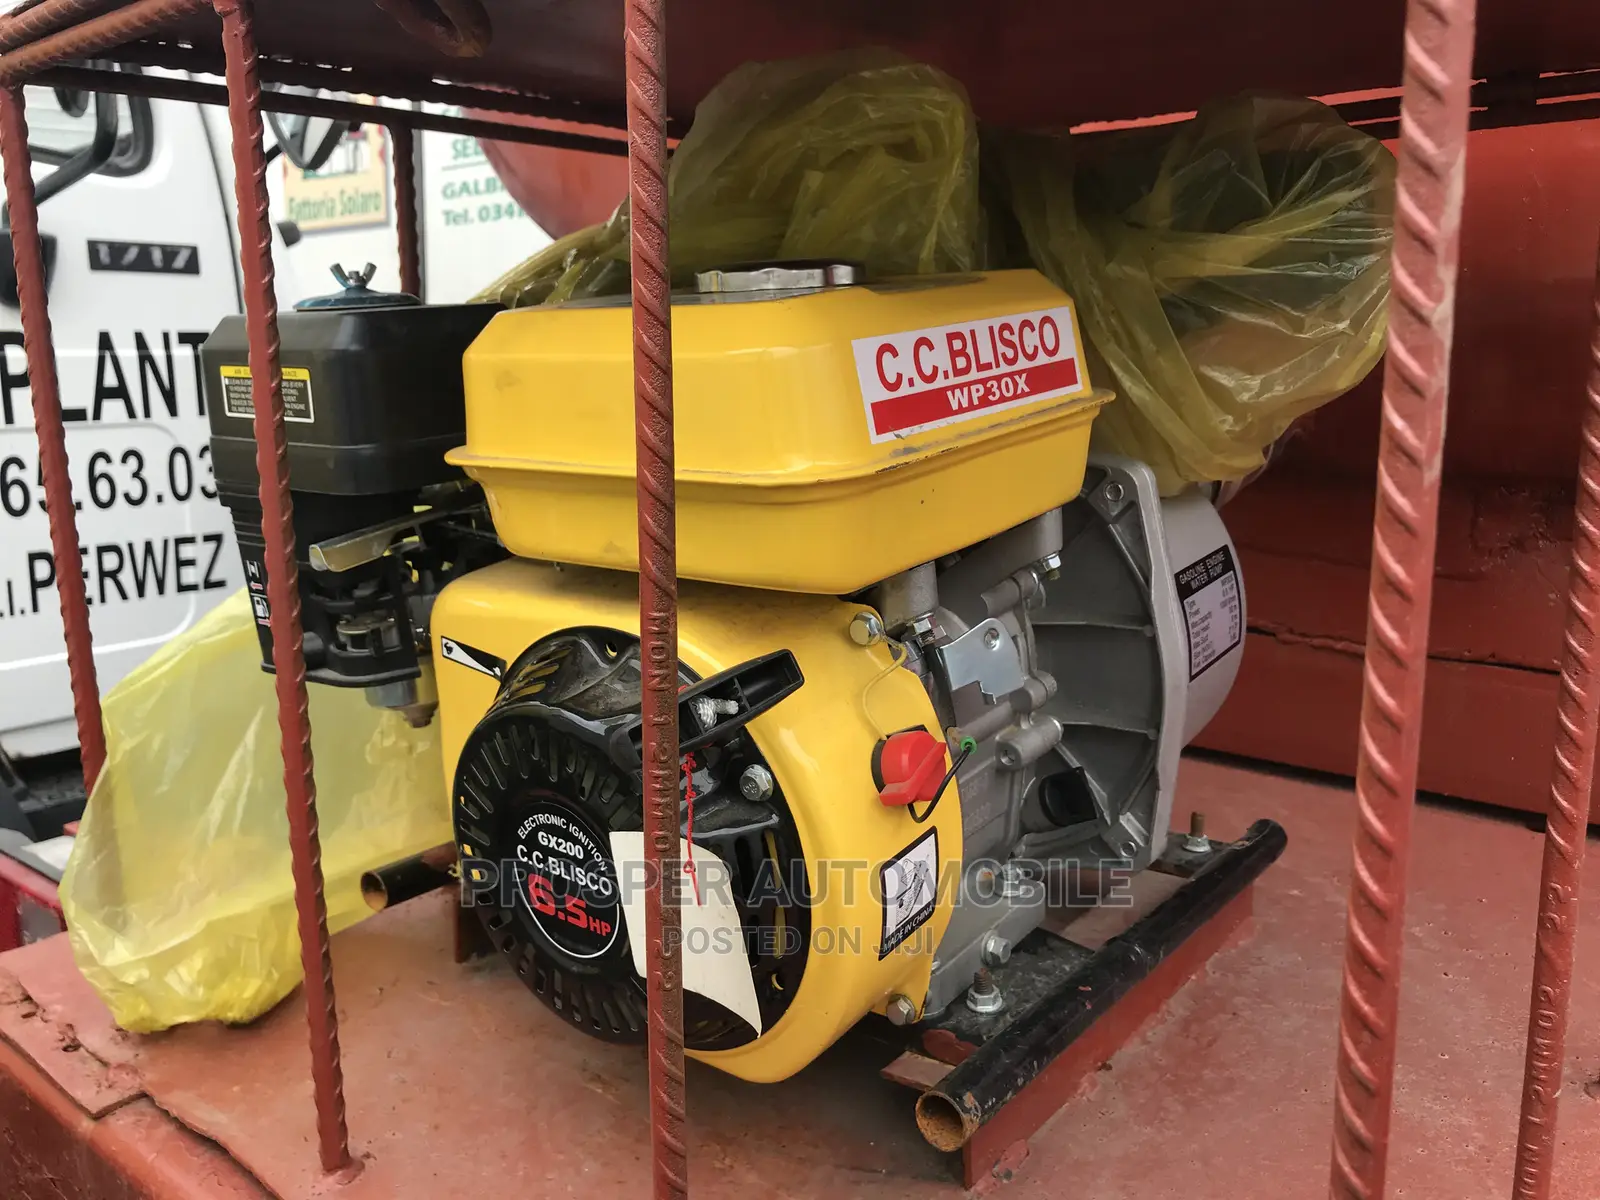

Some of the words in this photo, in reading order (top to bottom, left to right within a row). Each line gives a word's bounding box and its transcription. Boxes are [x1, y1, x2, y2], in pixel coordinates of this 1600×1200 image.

[442, 177, 506, 200] GALB
[442, 207, 474, 226] Tel.
[876, 315, 1060, 392] C.C.BLISCO
[947, 373, 1030, 411] WP30X
[1179, 562, 1206, 584] GASOLINE
[1206, 551, 1225, 569] ENGINE
[1190, 572, 1209, 590] WATER
[517, 813, 567, 839] ELECTRONIC
[568, 823, 608, 871] IGNITION
[537, 831, 584, 860] GX200
[516, 844, 613, 896] C.C.BLISCO
[883, 928, 904, 952] MADE
[904, 921, 912, 935] IN
[912, 905, 933, 926] CHINA
